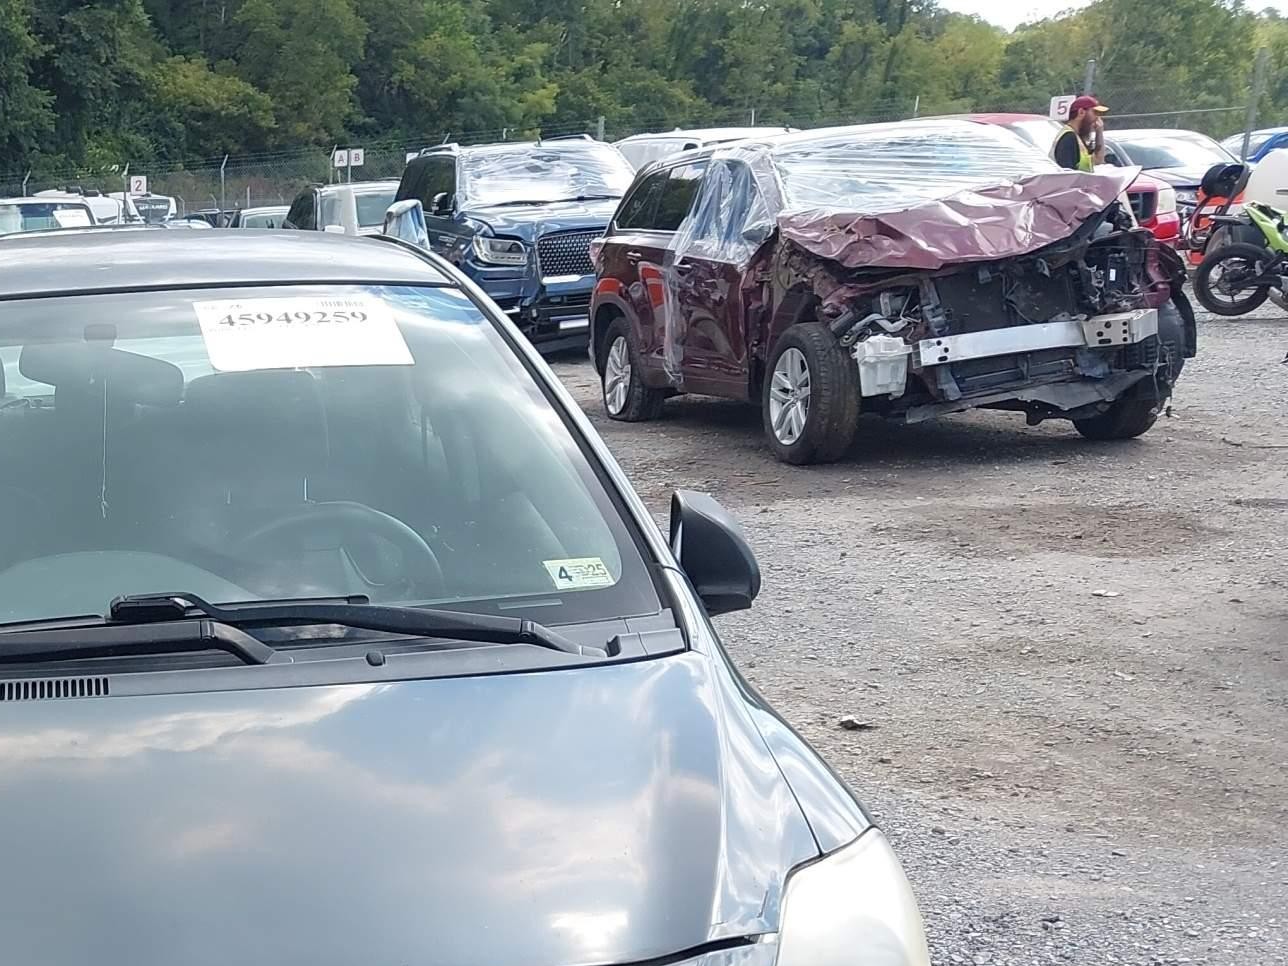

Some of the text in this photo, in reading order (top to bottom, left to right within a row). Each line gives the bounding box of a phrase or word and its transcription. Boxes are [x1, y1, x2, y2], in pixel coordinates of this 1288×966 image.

[1057, 101, 1068, 115] 5
[337, 154, 345, 164] A
[354, 153, 361, 162] B
[135, 180, 142, 192] 2
[219, 310, 368, 327] 45949259
[558, 566, 572, 582] 4
[588, 563, 607, 577] 25
